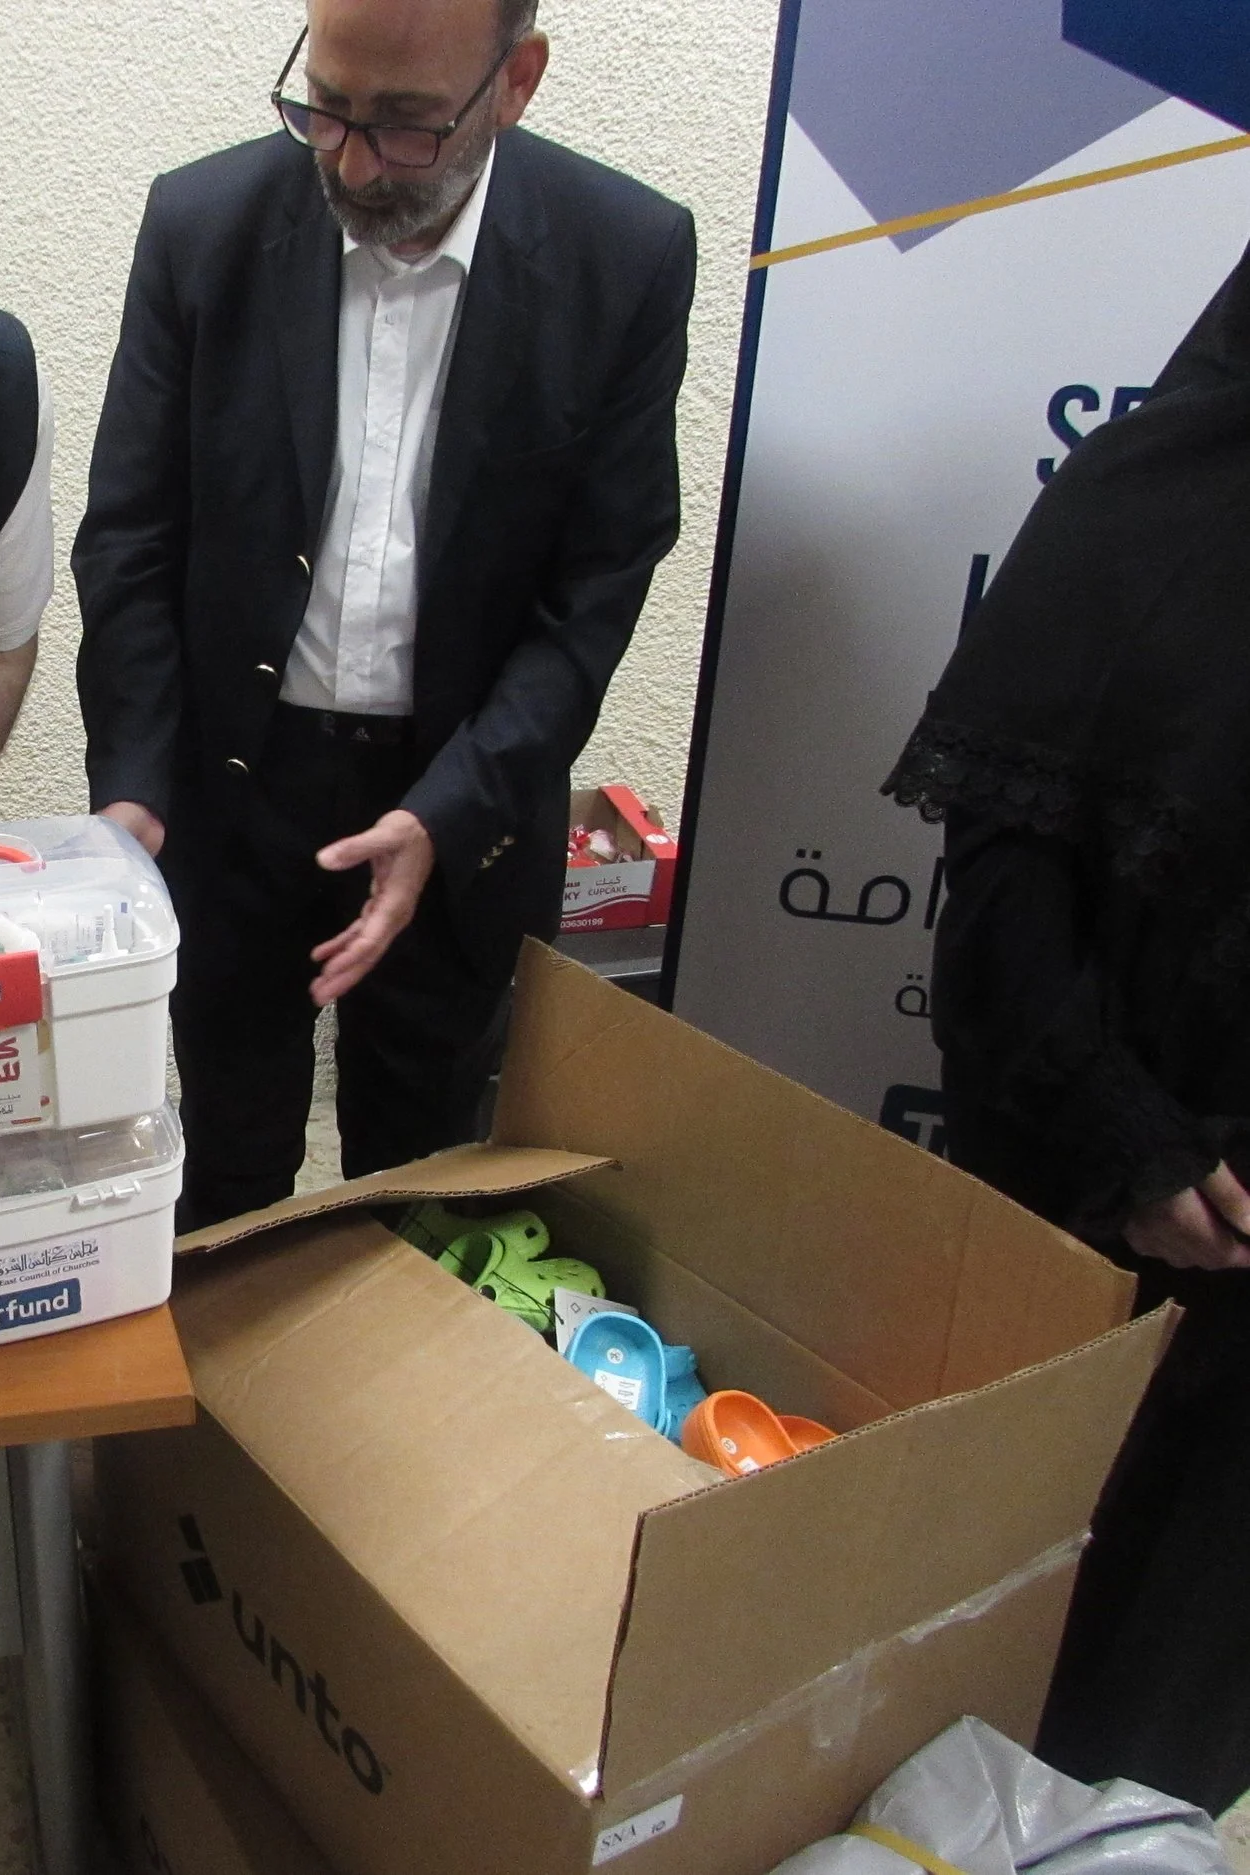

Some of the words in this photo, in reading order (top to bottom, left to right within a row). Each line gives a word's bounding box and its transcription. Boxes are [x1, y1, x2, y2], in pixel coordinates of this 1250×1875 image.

[588, 886, 628, 896] CUPCAKE
[69, 1239, 99, 1260] مجلس
[0, 1277, 17, 1287] East
[19, 1270, 51, 1282] Council
[52, 1267, 61, 1275] of
[63, 1260, 100, 1273] Churches
[232, 1587, 384, 1796] unto
